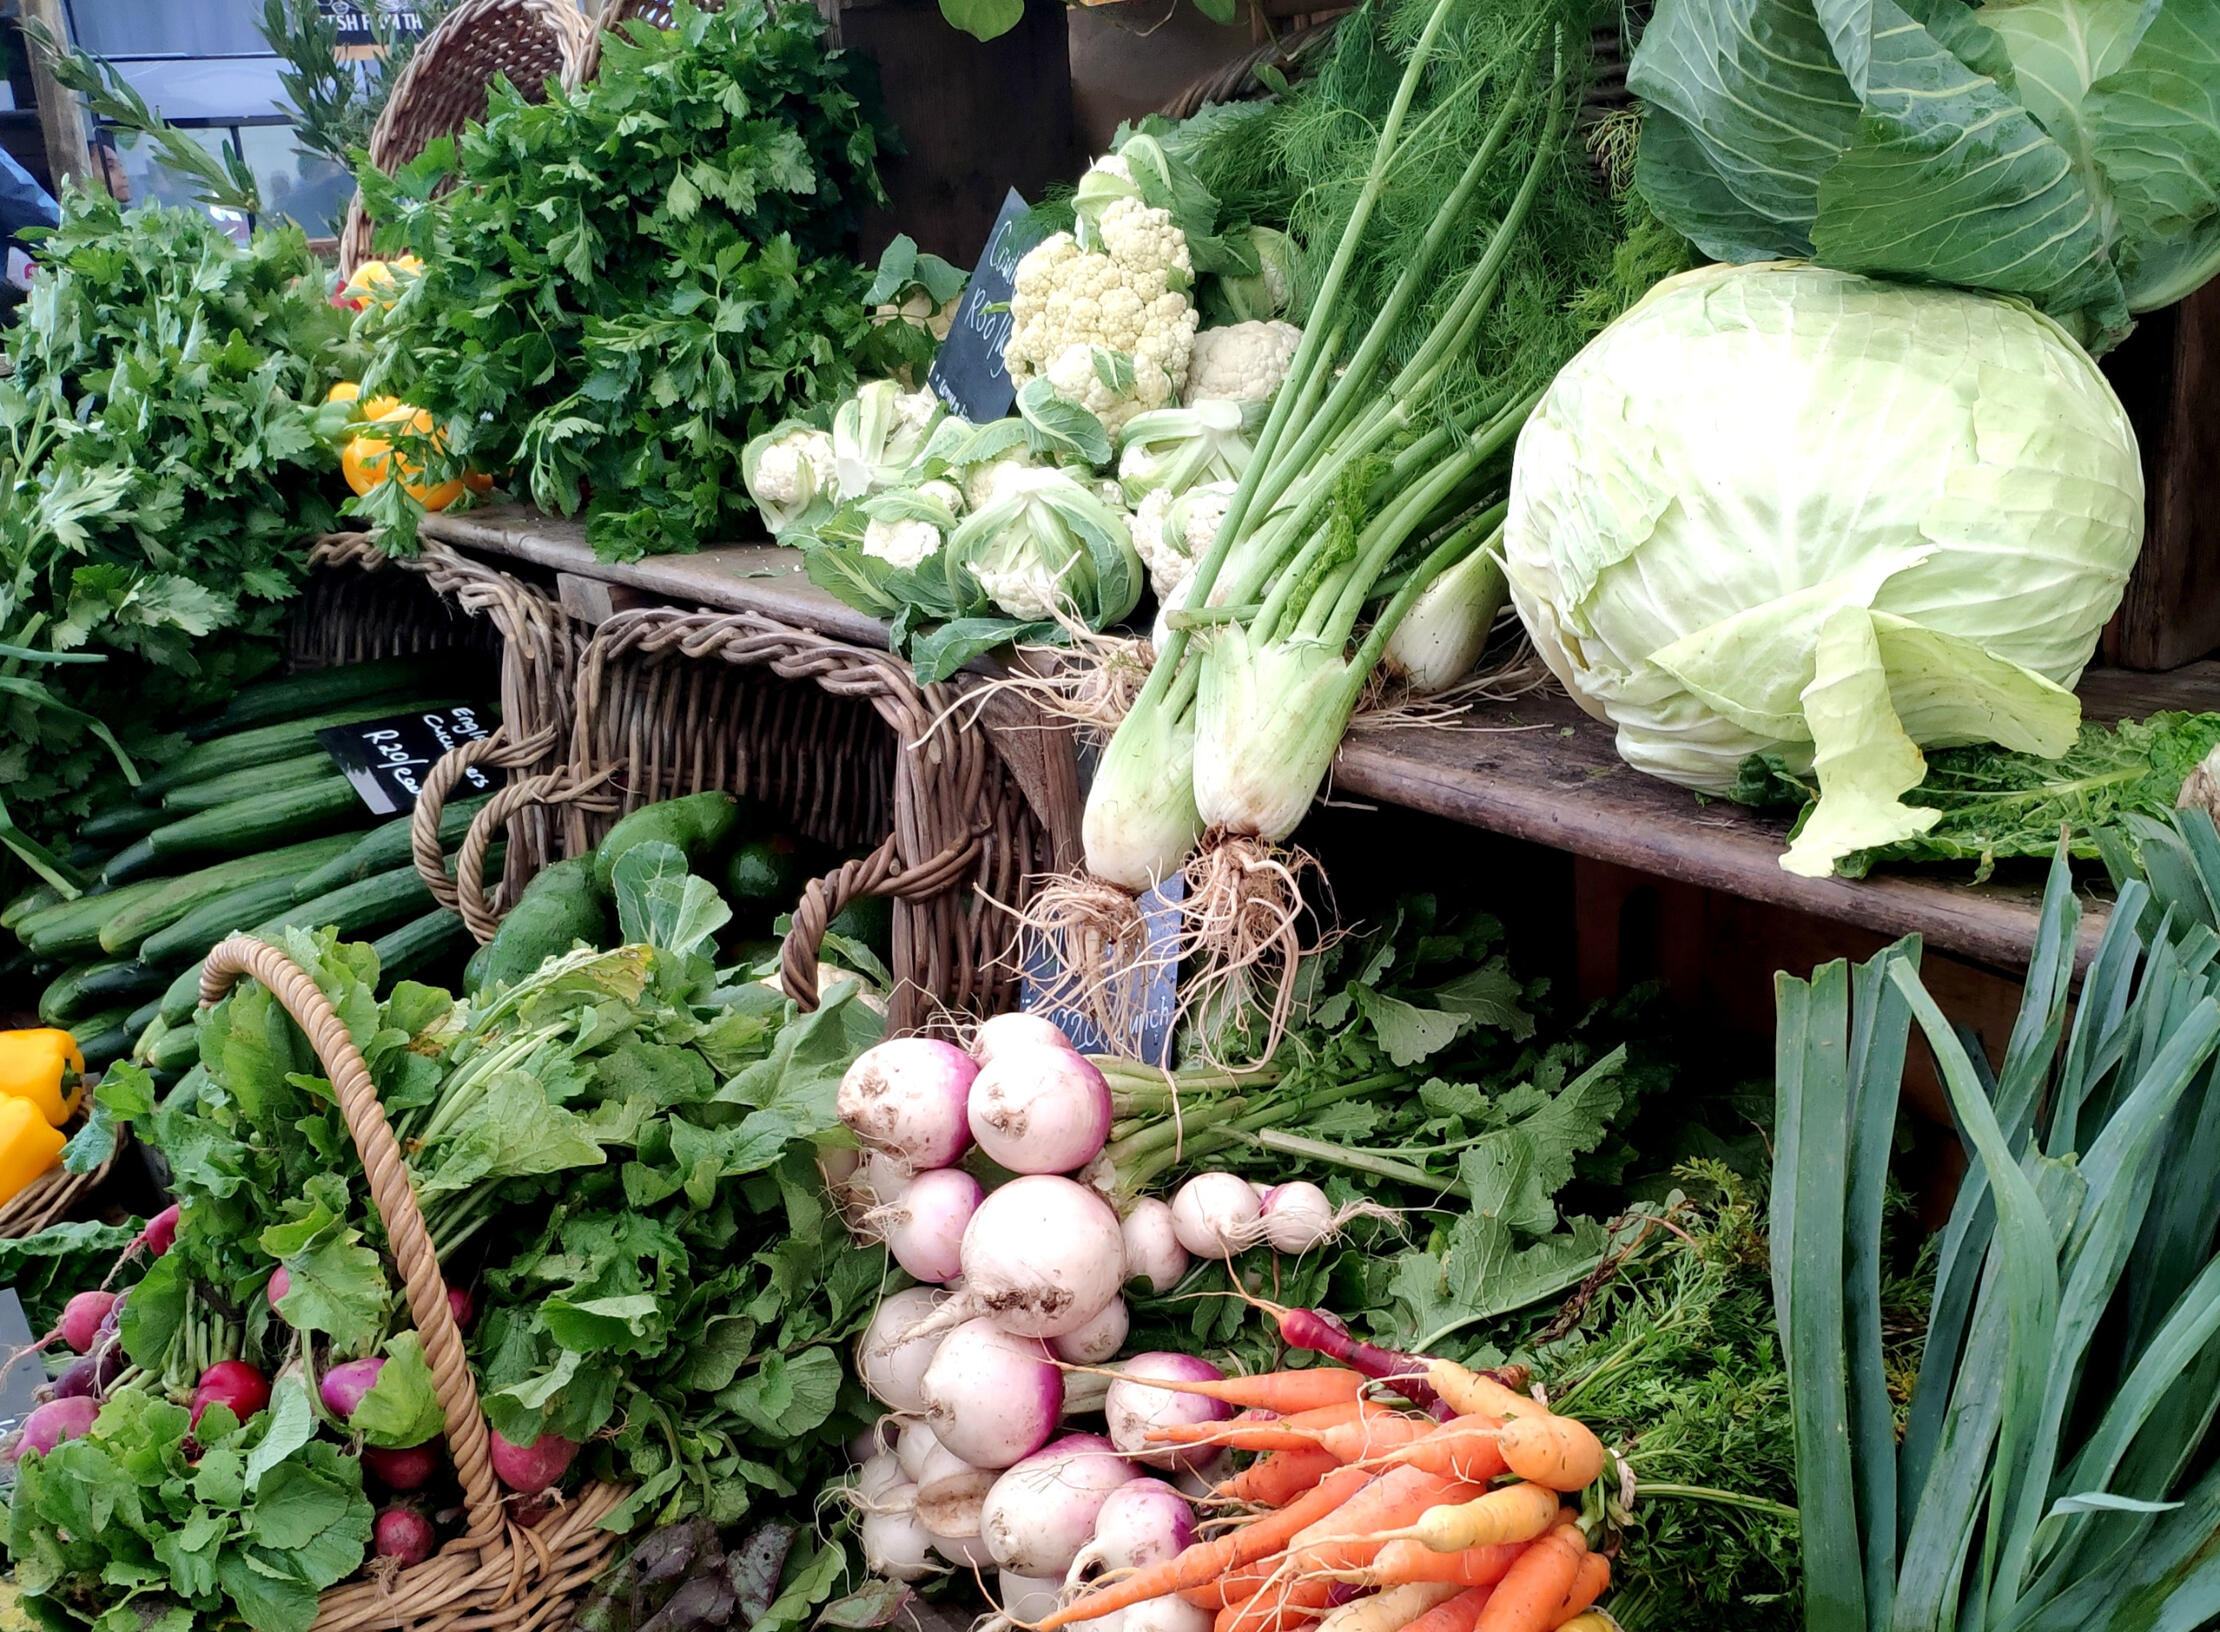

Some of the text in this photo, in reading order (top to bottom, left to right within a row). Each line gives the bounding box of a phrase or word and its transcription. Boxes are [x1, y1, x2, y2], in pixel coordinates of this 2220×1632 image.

[401, 13, 424, 30] TH
[451, 707, 488, 742] Engli
[424, 714, 489, 788] Cucuers
